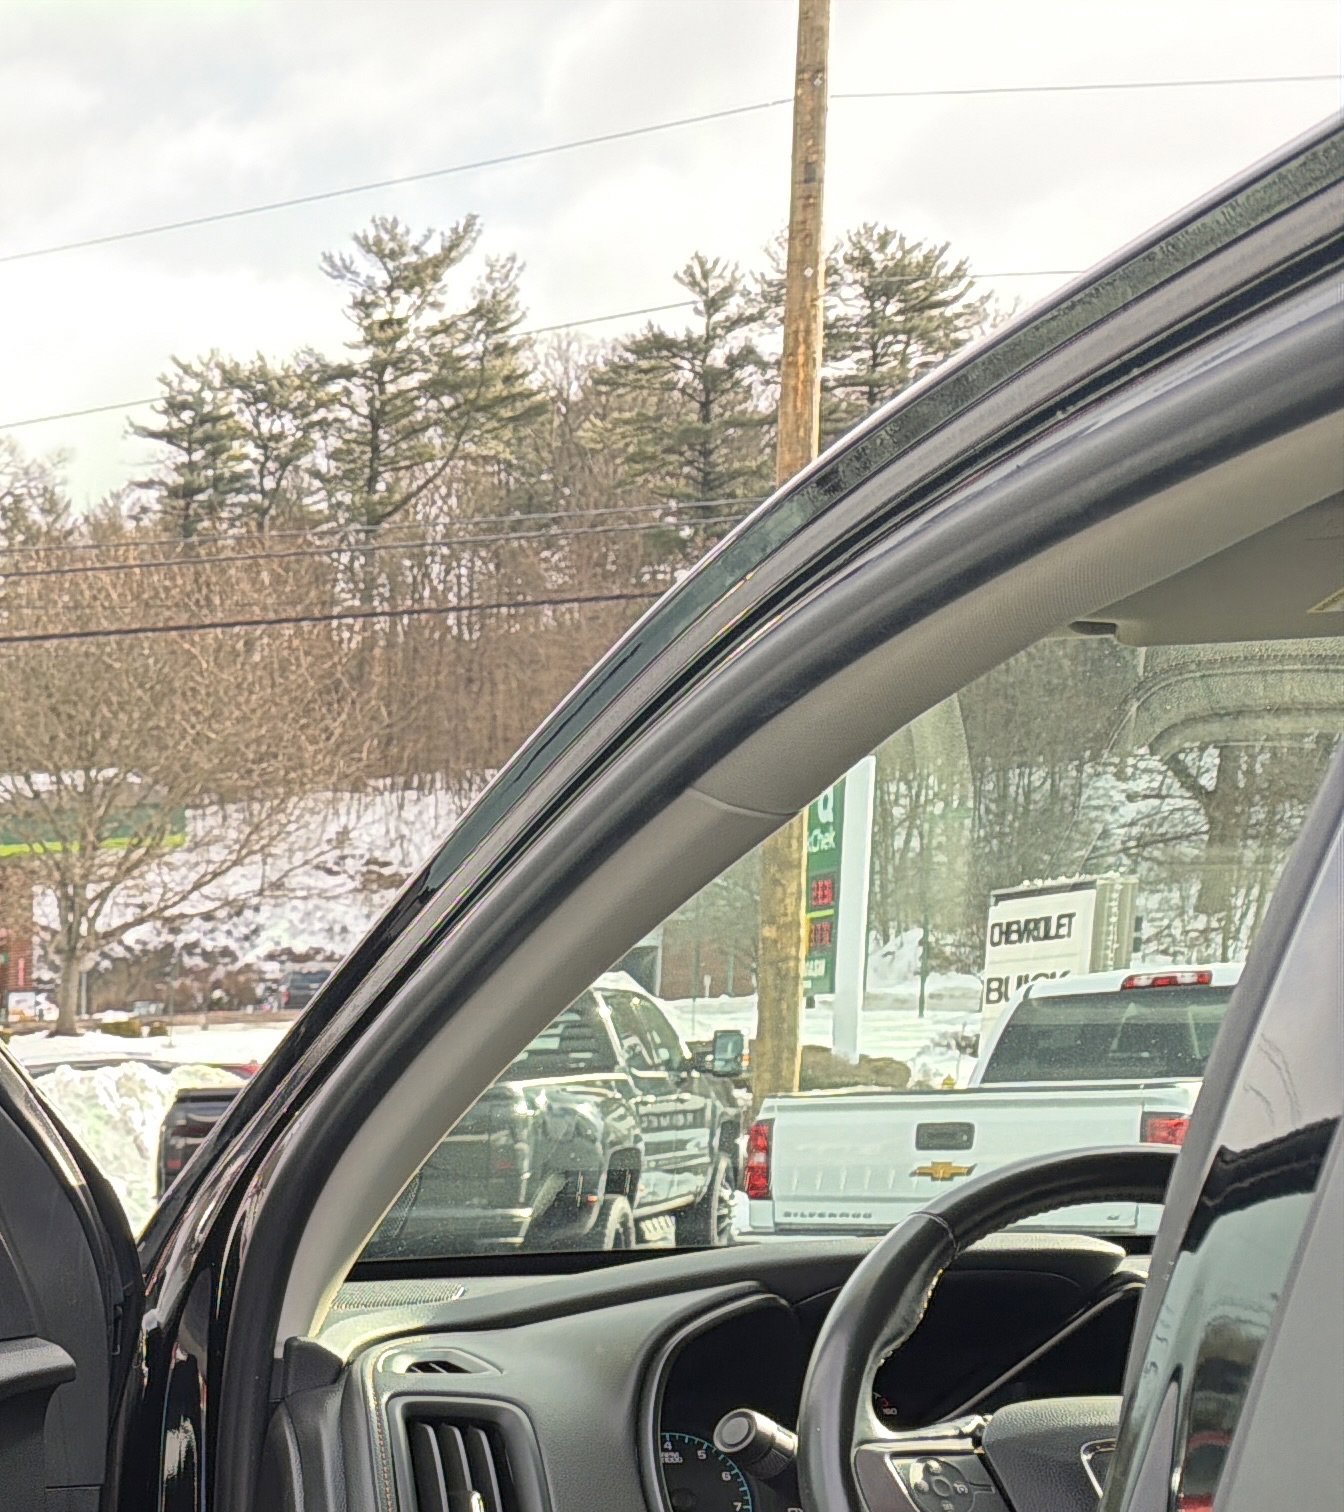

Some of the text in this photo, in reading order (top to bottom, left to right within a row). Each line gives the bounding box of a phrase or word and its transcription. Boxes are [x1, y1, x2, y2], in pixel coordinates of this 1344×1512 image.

[990, 912, 1076, 947] CHEVROLET
[664, 1441, 672, 1450] 4
[697, 1450, 707, 1459] 5
[721, 1472, 731, 1481] 6
[733, 1502, 742, 1512] 7
